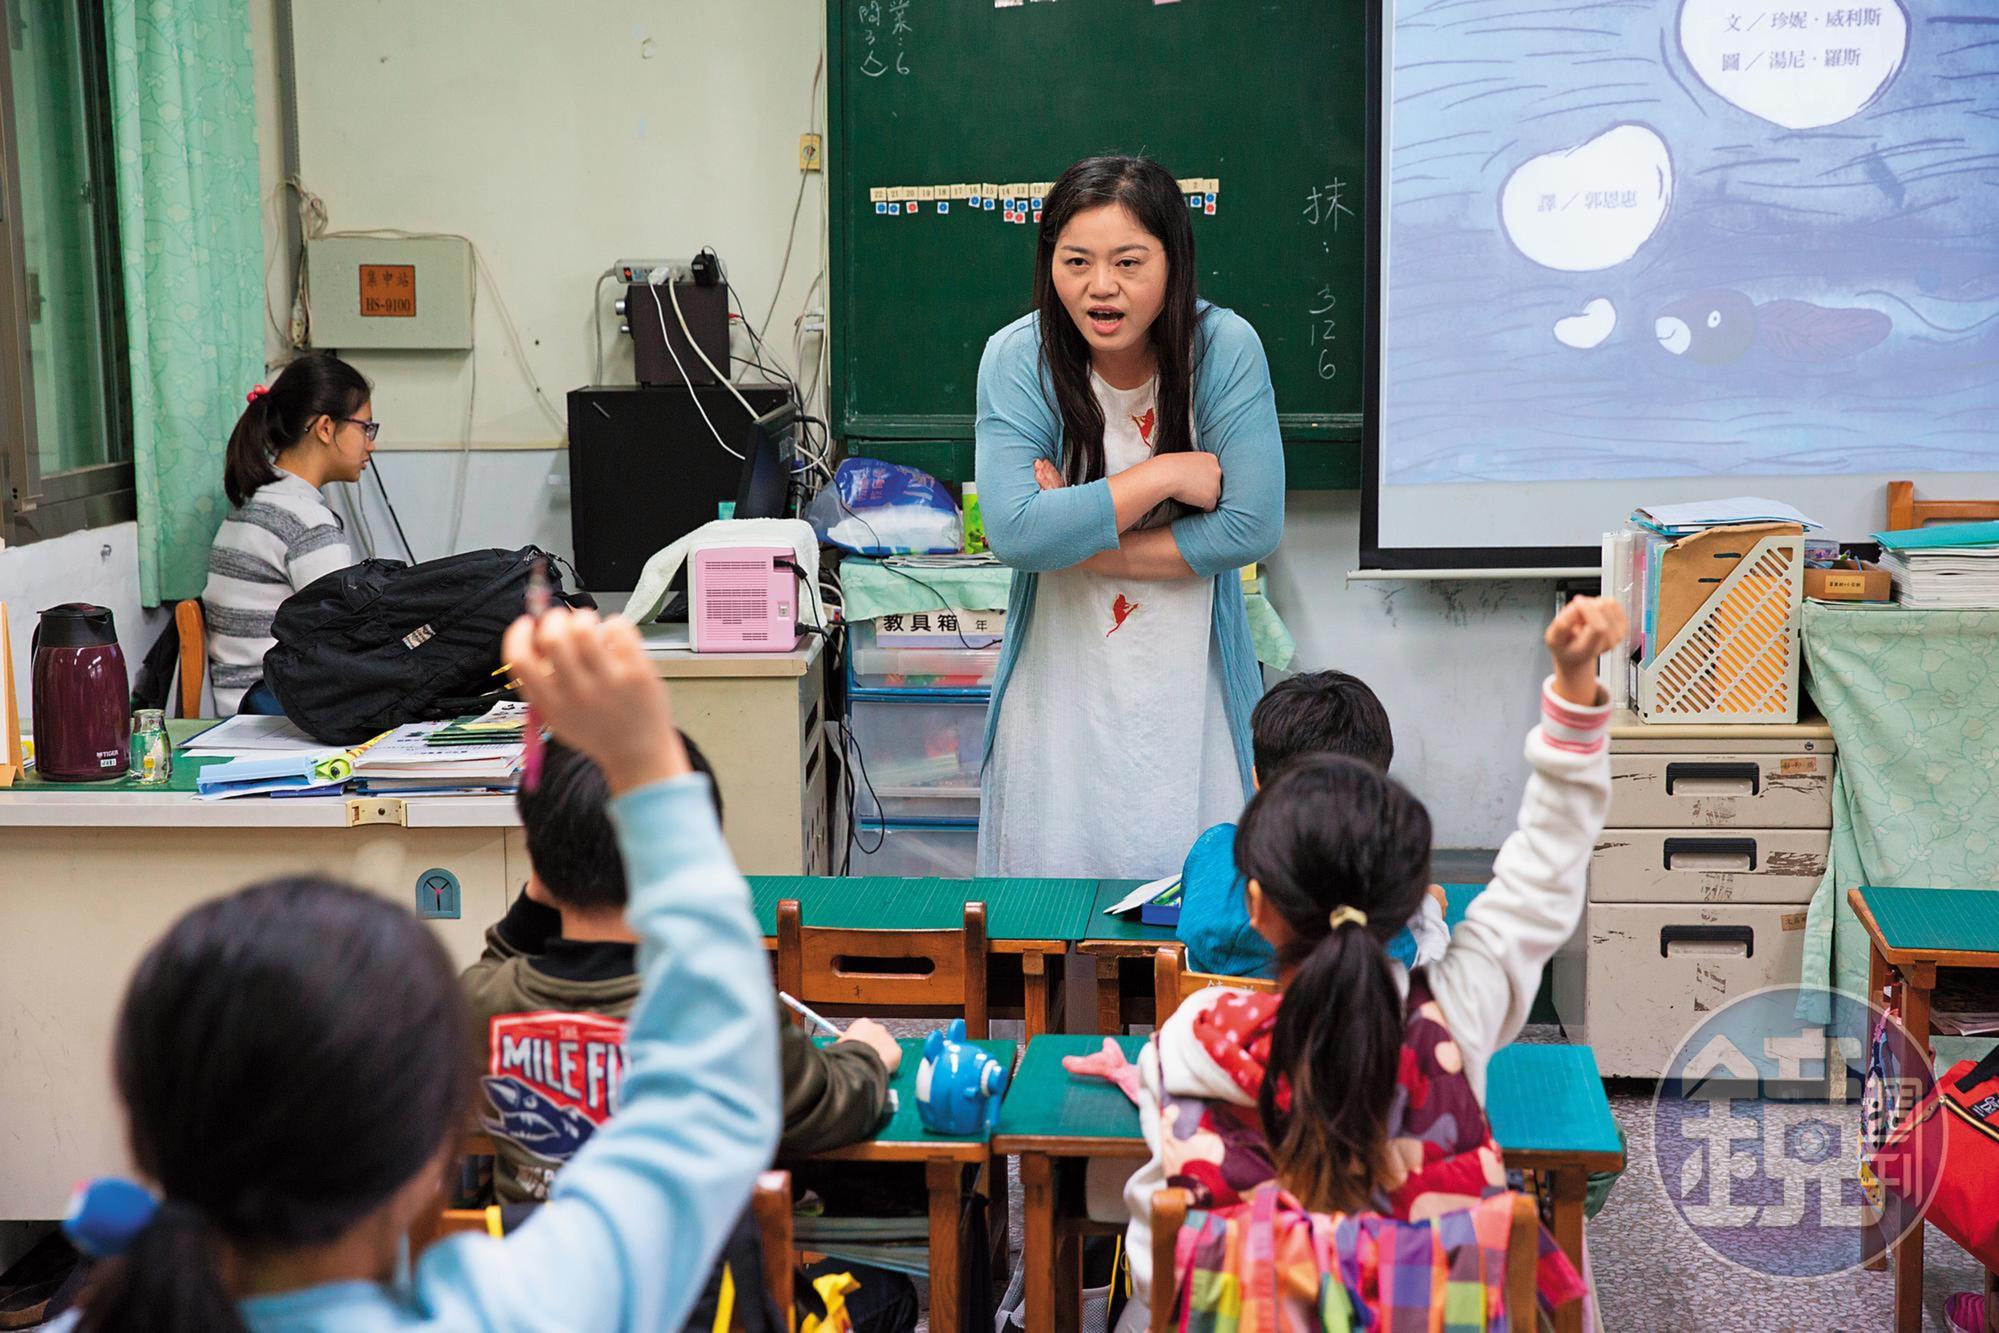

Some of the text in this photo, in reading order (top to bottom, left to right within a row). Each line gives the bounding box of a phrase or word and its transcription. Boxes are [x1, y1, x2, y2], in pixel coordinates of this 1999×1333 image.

[1319, 348, 1336, 380] 6
[883, 614, 988, 632] 教具箱 年
[102, 750, 119, 758] TIGER
[558, 1024, 580, 1040] THE
[502, 1034, 582, 1100] MILE
